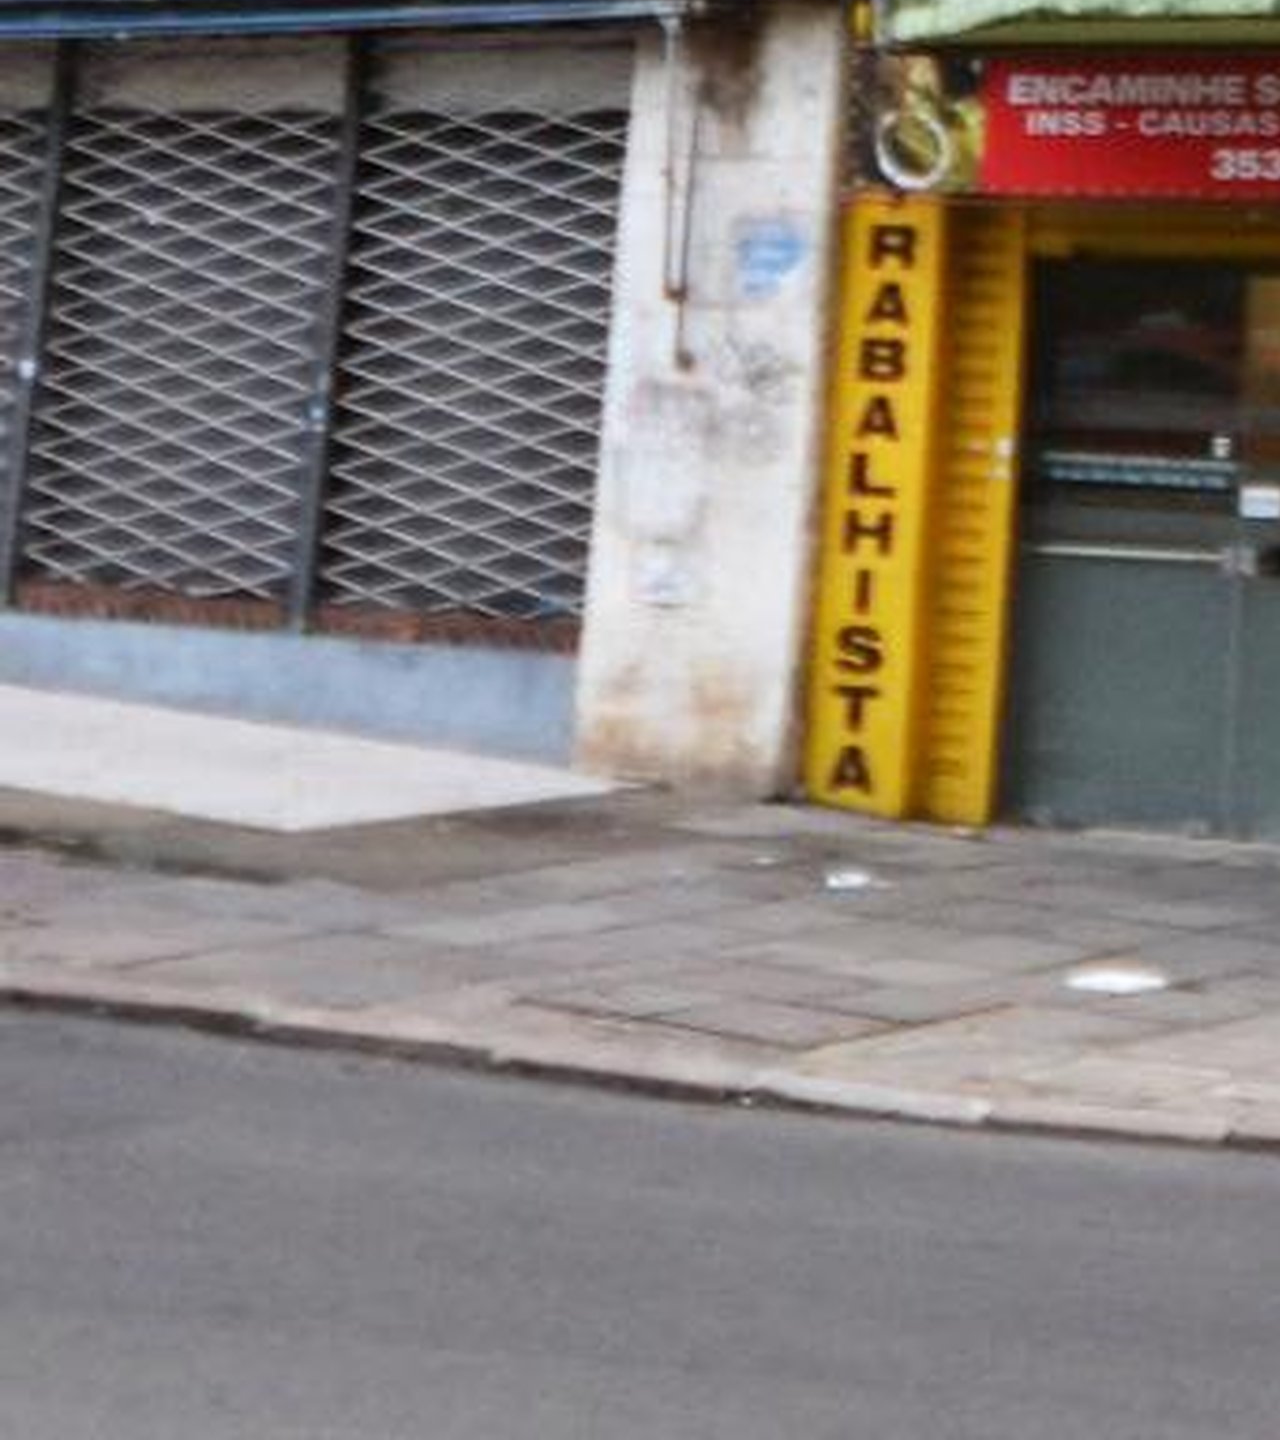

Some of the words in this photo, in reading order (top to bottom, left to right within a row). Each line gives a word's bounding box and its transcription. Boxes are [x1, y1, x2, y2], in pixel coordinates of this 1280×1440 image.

[1007, 73, 1246, 106] ENCAMINHE
[1026, 111, 1103, 137] INSS
[1138, 110, 1280, 137] CAUSAS
[832, 192, 918, 795] RABALHISTA
